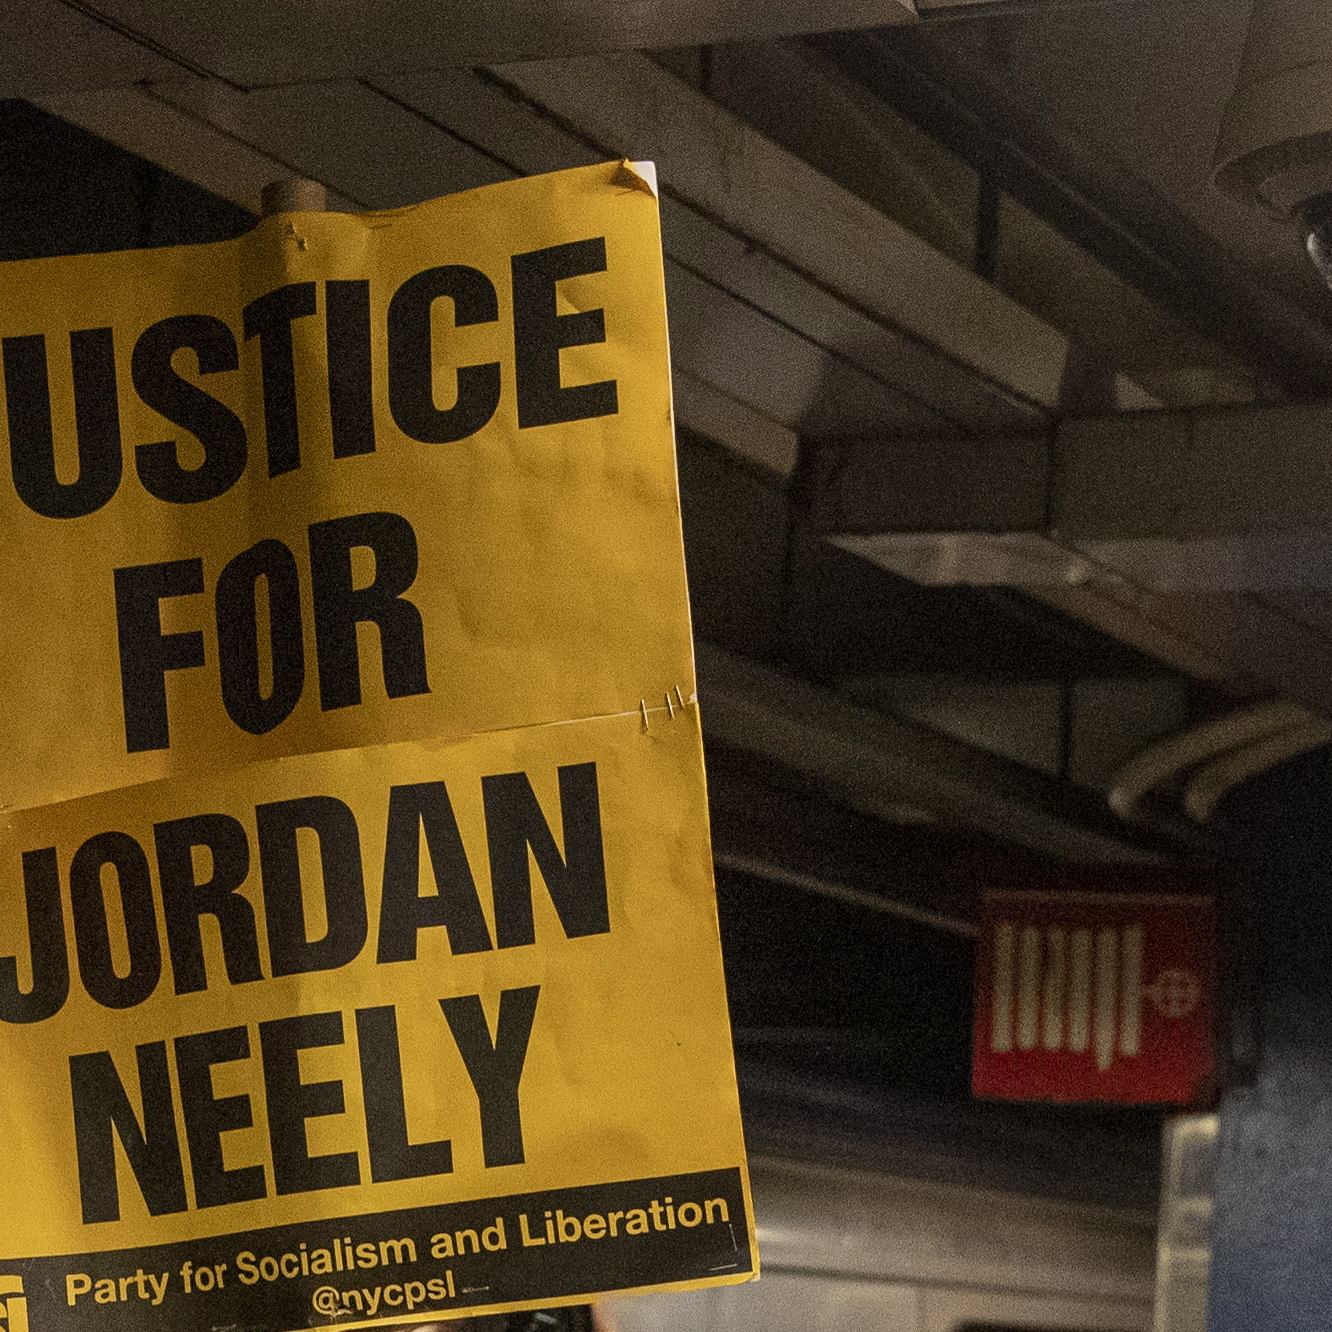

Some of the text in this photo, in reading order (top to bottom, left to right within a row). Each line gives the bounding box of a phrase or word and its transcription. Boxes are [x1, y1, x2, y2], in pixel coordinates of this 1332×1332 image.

[114, 511, 433, 755] FOR
[69, 985, 542, 1226] NEELY
[65, 1196, 731, 1307] Party for Socialism and Liberation
[312, 1269, 457, 1316] @nycpsl
